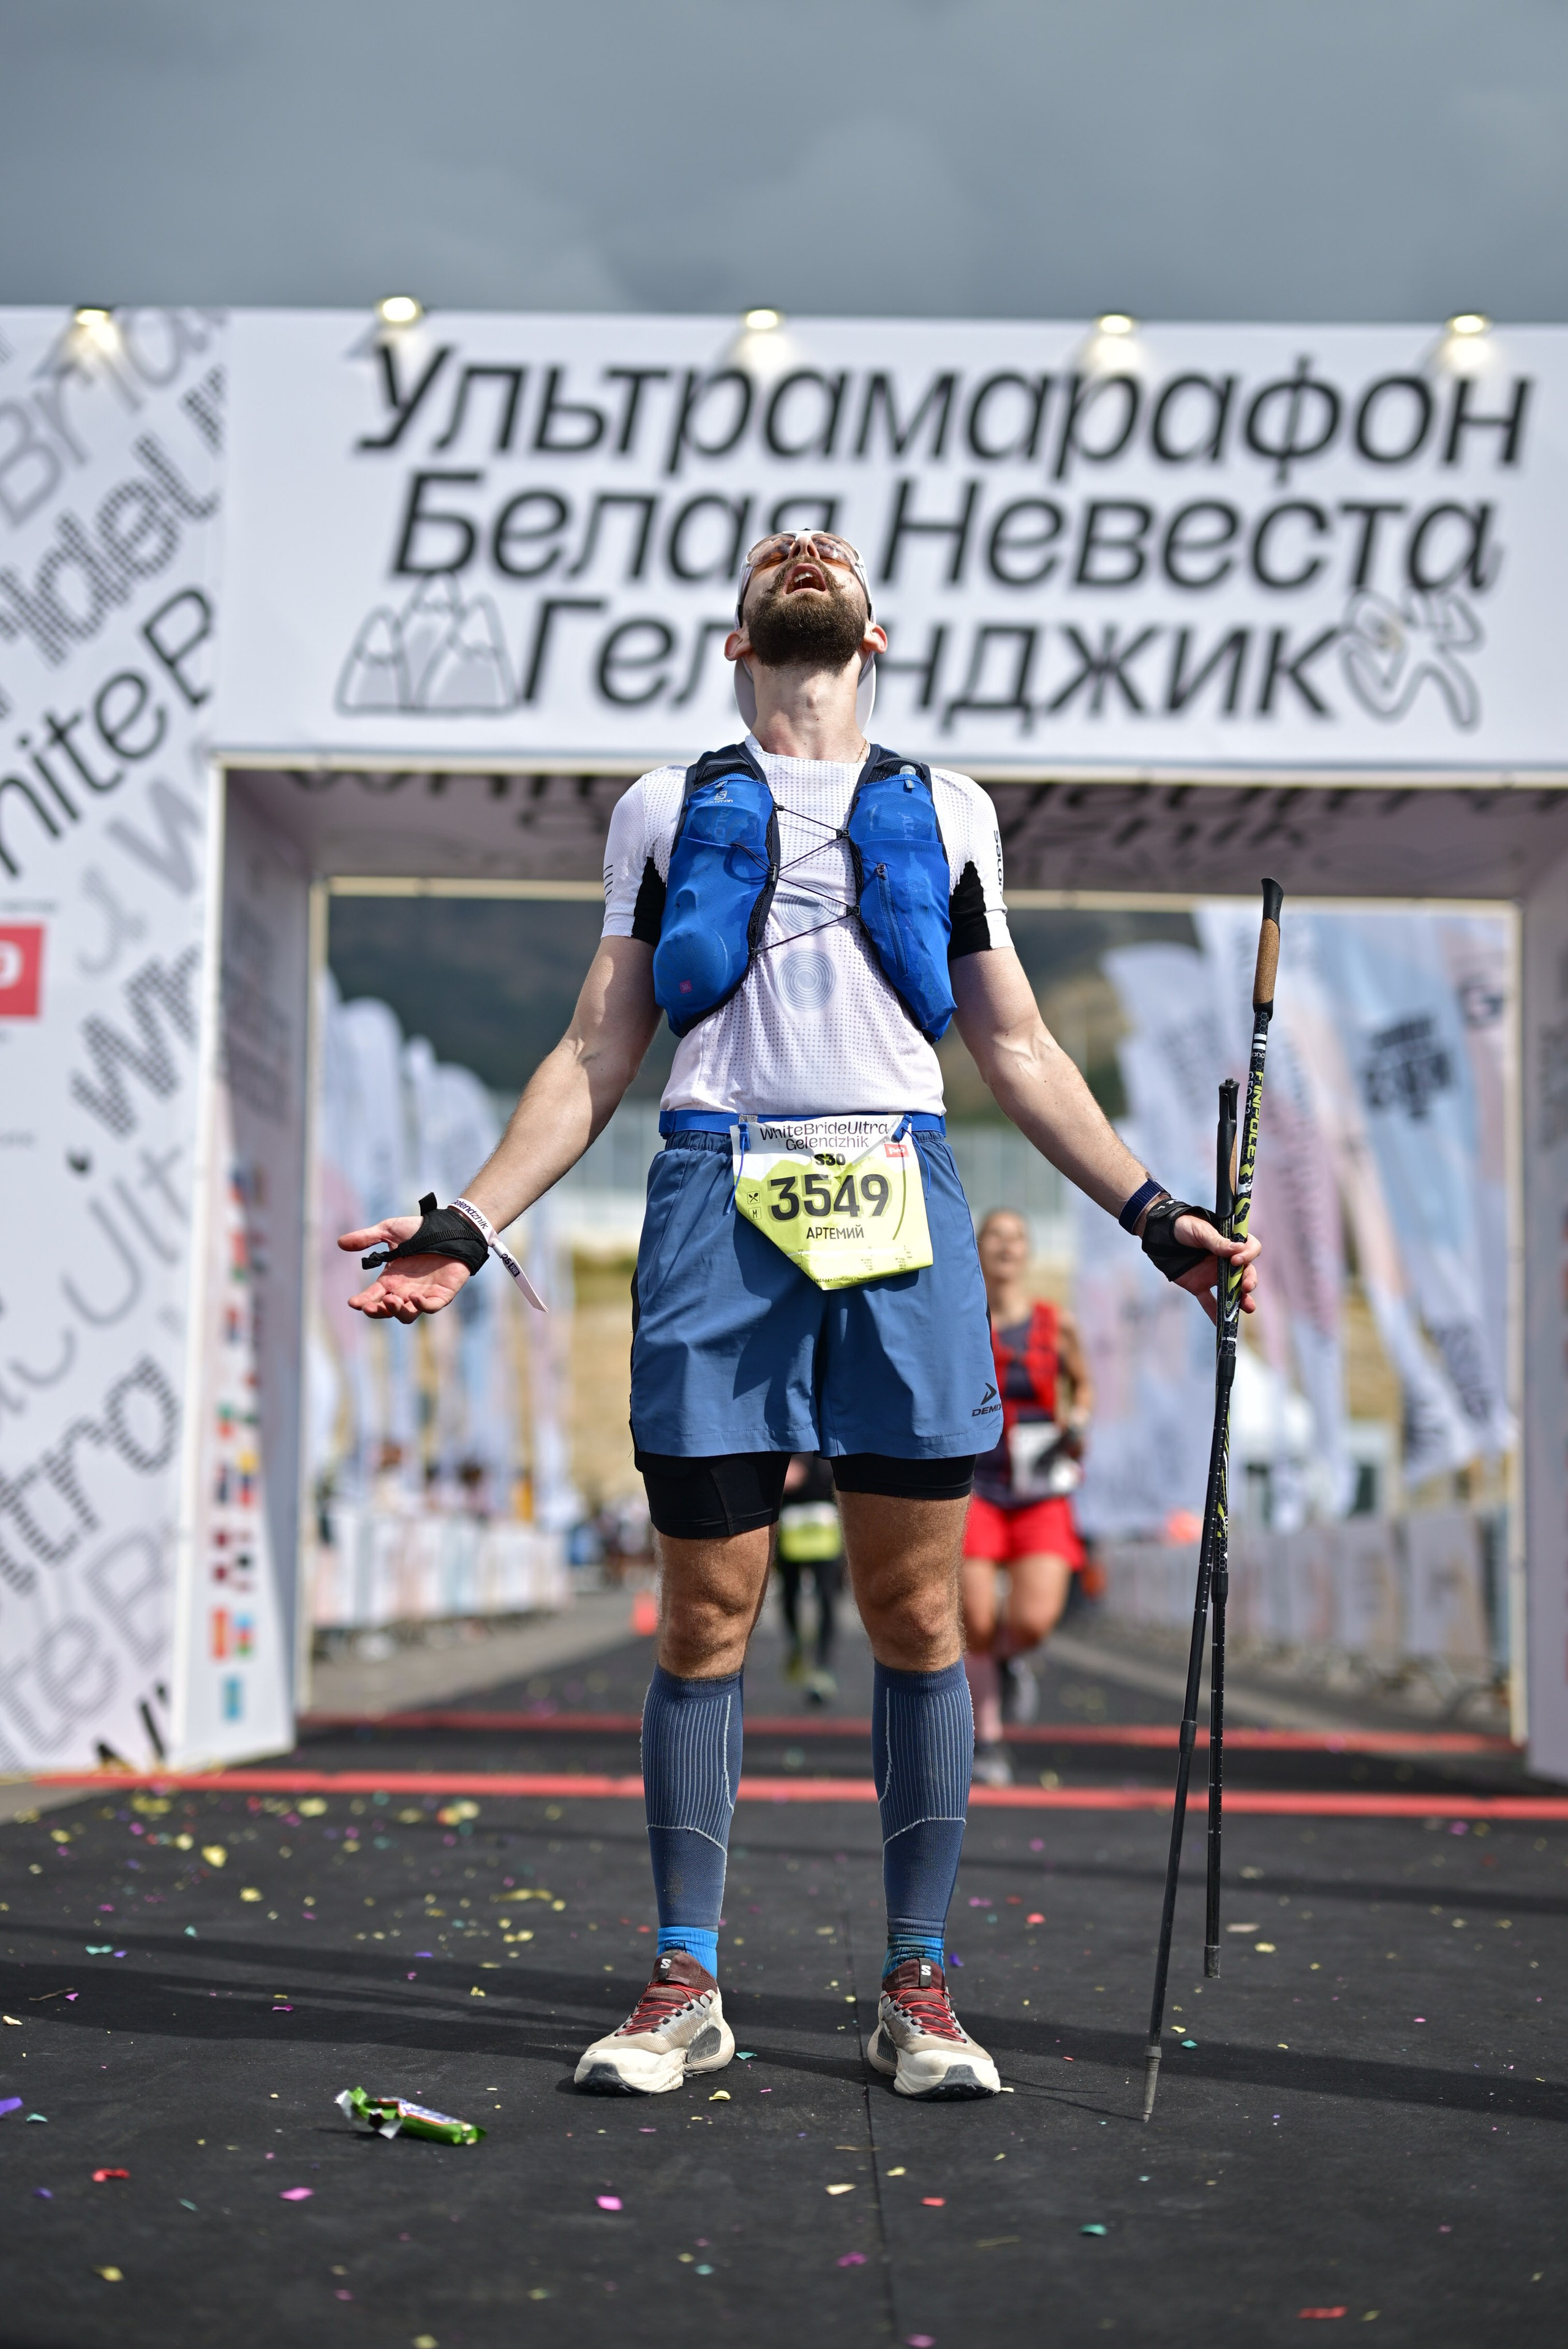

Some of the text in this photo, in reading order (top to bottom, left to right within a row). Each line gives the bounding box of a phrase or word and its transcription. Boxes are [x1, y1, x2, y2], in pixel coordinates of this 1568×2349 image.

[353, 343, 1535, 487] Ультрамарафон
[876, 477, 1498, 592] Невеста
[522, 598, 1346, 734] Гелнджик
[760, 1121, 889, 1141] WhiteBrideUltra
[1247, 1071, 1264, 1159] FINPOLE
[786, 1135, 869, 1151] Gelendzhik
[814, 1153, 846, 1166] S30
[769, 1174, 892, 1222] 3549
[806, 1224, 865, 1239] АРТЕМИЙ
